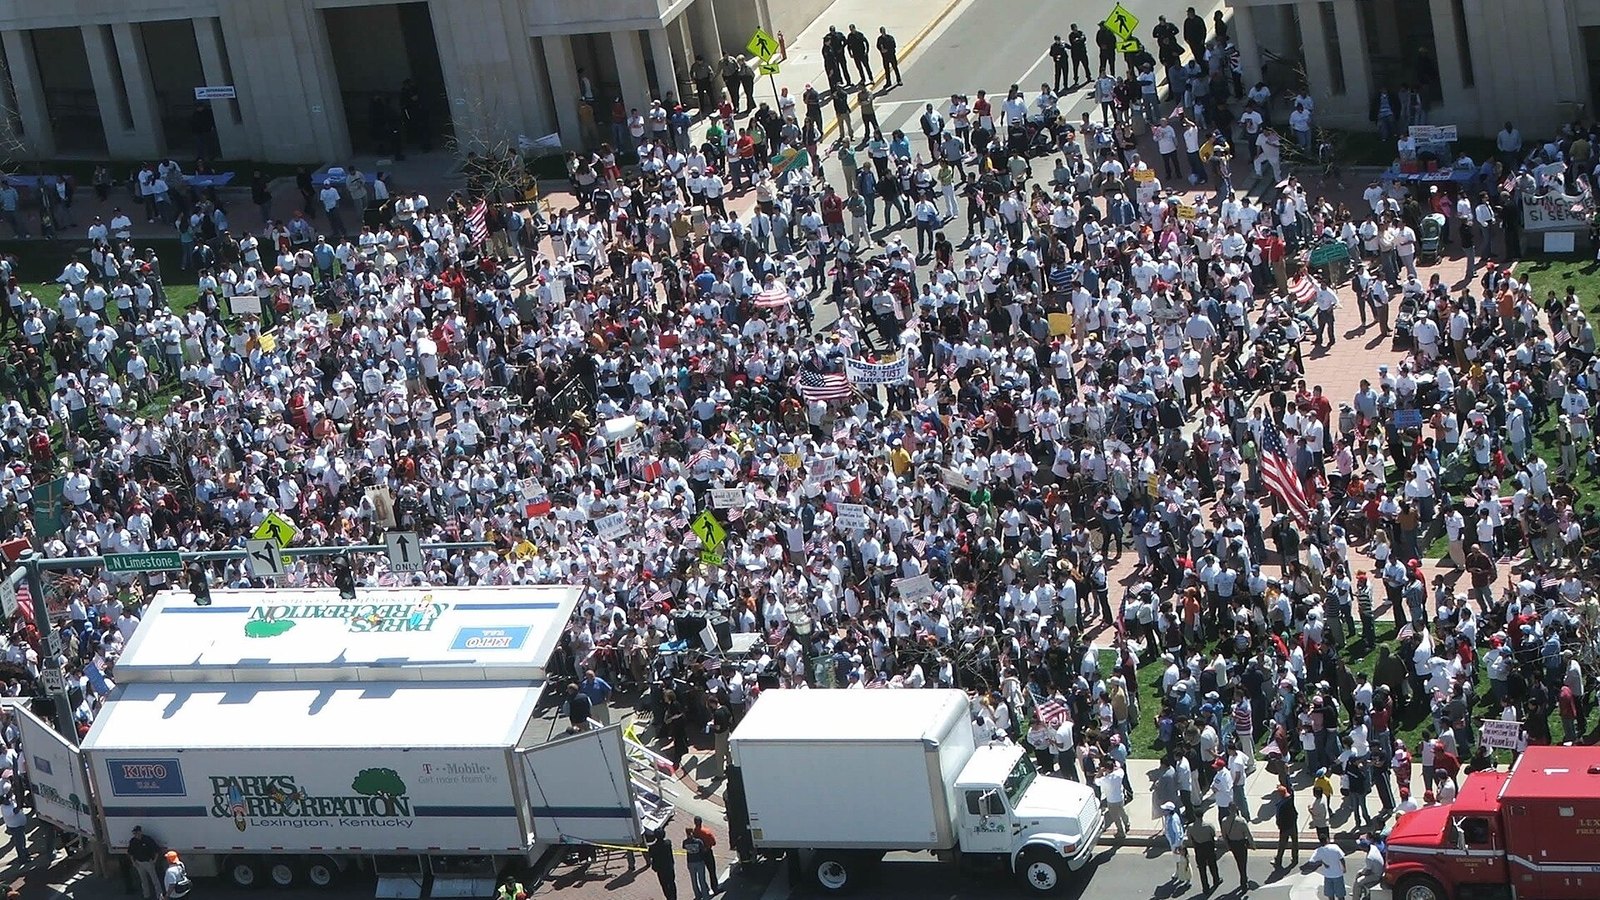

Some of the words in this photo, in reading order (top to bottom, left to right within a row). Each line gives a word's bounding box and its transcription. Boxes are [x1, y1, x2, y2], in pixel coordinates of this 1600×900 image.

[1530, 210, 1543, 221] SI
[881, 369, 901, 378] JUST
[112, 557, 121, 568] N
[122, 556, 172, 568] Limestone
[466, 638, 511, 647] KITO
[123, 765, 167, 779] KITO
[209, 776, 298, 796] PARKS
[246, 796, 410, 817] RECREATION
[251, 818, 334, 828] Lexington,
[340, 818, 414, 828] Kentucky
